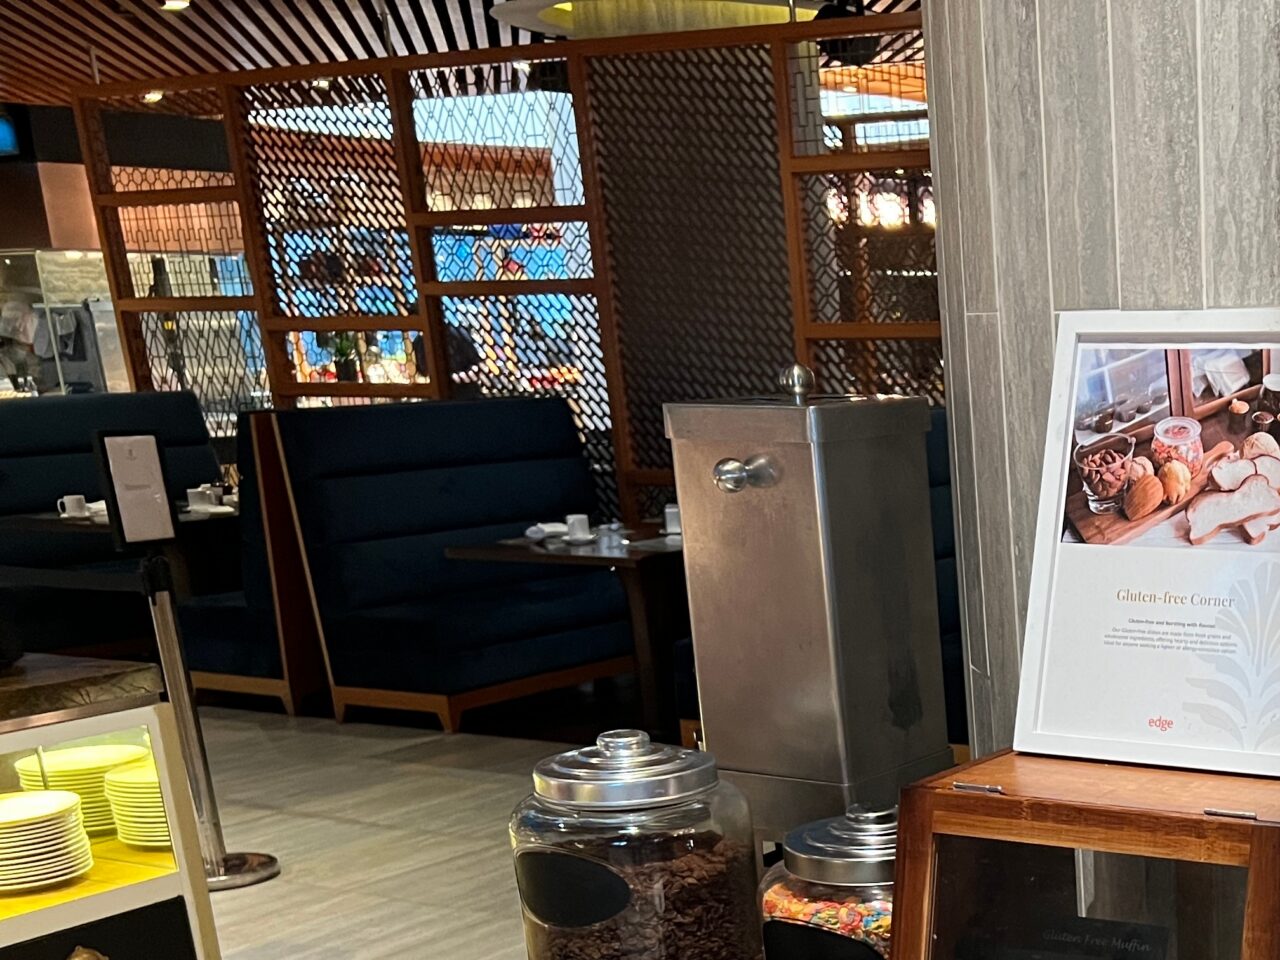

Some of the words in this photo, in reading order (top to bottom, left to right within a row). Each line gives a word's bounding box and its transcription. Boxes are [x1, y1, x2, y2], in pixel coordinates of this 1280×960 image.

[1117, 588, 1187, 605] Gluten-free
[1191, 592, 1235, 608] Corner
[1148, 715, 1174, 731] edge
[1111, 936, 1151, 951] Muffin
